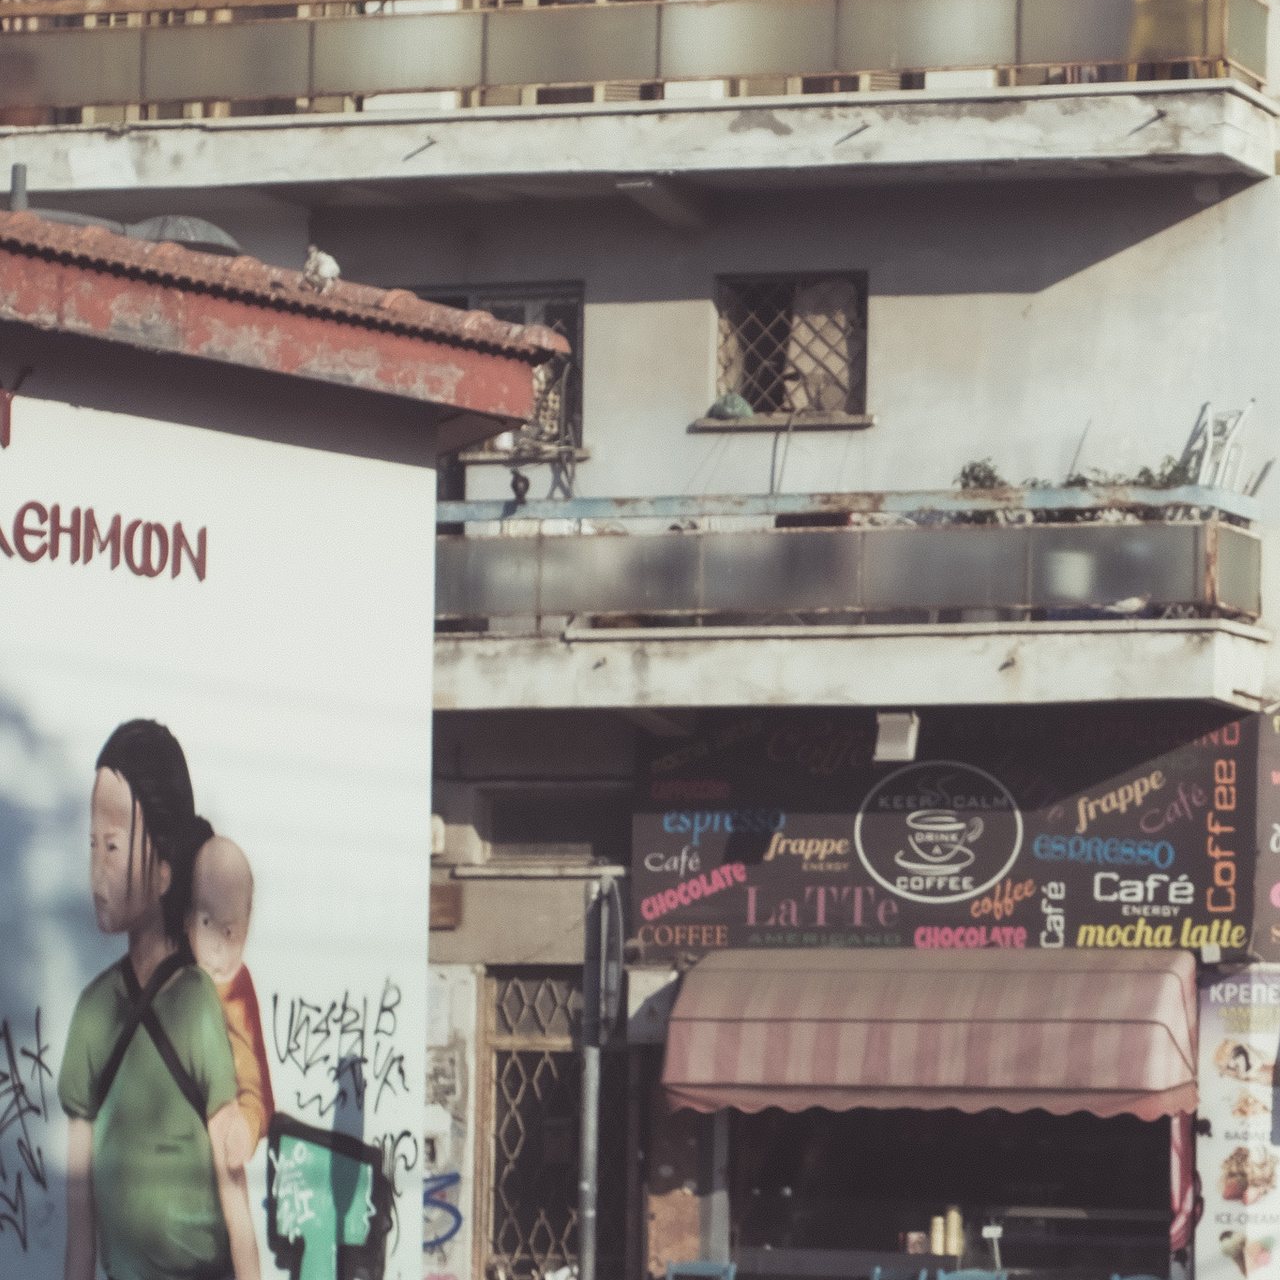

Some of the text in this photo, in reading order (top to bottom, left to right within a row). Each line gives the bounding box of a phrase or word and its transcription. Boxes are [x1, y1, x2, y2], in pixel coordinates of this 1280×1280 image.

[1076, 769, 1166, 834] frappe
[763, 831, 850, 862] frappe
[914, 831, 959, 843] DRINK
[1207, 759, 1237, 913] Coffee
[643, 844, 701, 878] Café
[896, 876, 975, 891] COFFEE
[970, 877, 1037, 921] coffee
[1093, 872, 1195, 905] Café
[1040, 880, 1066, 949] Café
[637, 923, 729, 948] COFFEE
[1077, 917, 1247, 949] mocha latte
